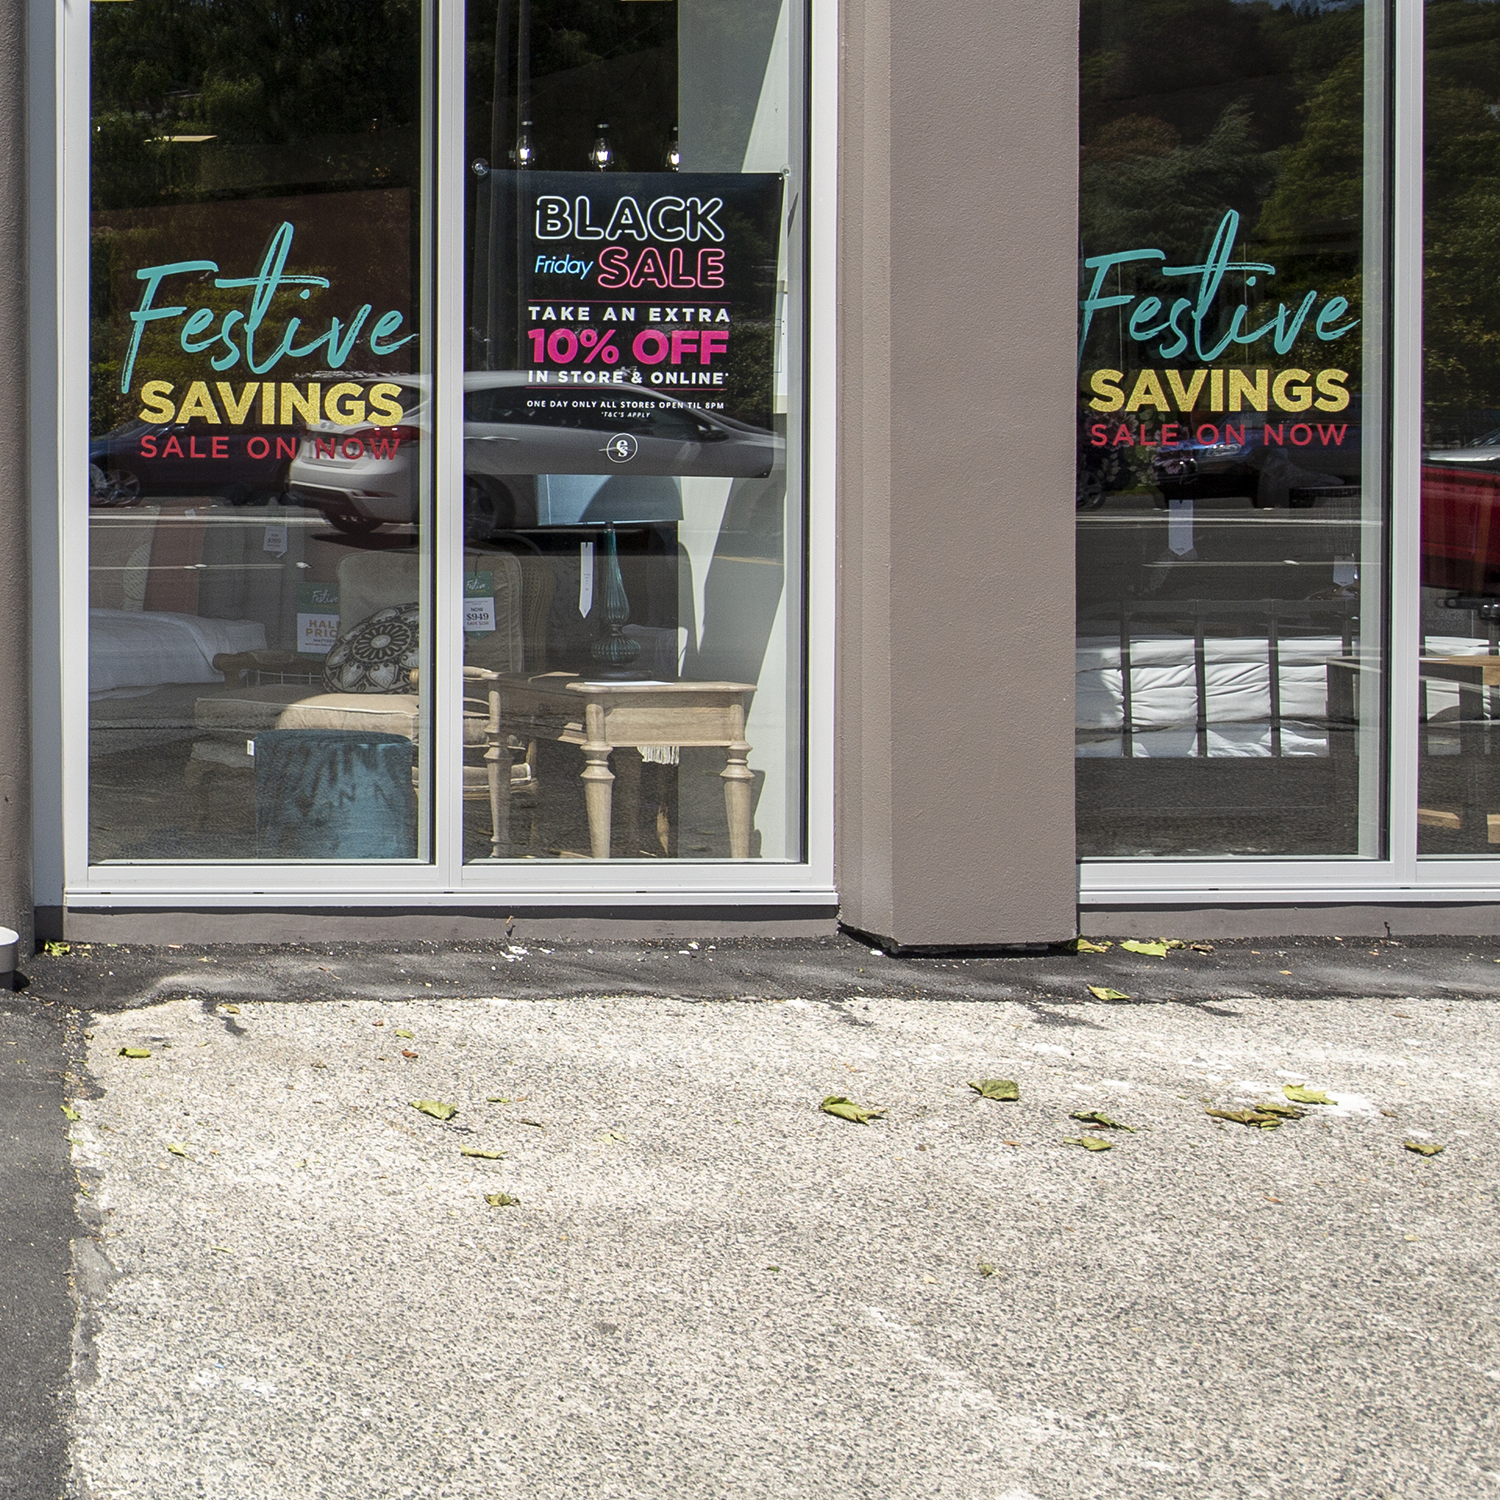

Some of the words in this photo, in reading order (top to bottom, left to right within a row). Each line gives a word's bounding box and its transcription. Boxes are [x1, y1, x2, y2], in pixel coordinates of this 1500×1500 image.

[535, 195, 725, 242] BLACK
[534, 254, 594, 280] Friday
[597, 246, 725, 289] SALE
[1077, 209, 1361, 371] Festive
[121, 221, 419, 393] Festive
[528, 306, 591, 322] TAKE
[602, 307, 636, 322] AN
[649, 307, 730, 323] EXTRA
[527, 328, 620, 365] 10%
[632, 329, 729, 365] OFF
[528, 370, 549, 383] IN
[557, 370, 624, 384] STORE
[630, 371, 643, 384] &
[1088, 368, 1351, 414] SAVINGS
[139, 380, 404, 427] SAVINGS
[526, 400, 547, 408] ONE
[550, 400, 569, 408] DAY
[571, 400, 597, 408] ONLY
[600, 401, 617, 409] ALL
[620, 401, 656, 409] STORES
[658, 401, 684, 409] OPEN
[687, 402, 702, 410] TIL
[704, 402, 725, 410] 8PM
[627, 411, 651, 419] APPLY
[140, 435, 229, 459] SALE
[247, 436, 297, 460] ON
[315, 437, 400, 461] NOW
[1090, 423, 1179, 447] SALE
[1196, 423, 1245, 447] ON
[1263, 423, 1349, 447] NOW
[305, 628, 338, 638] PRIC
